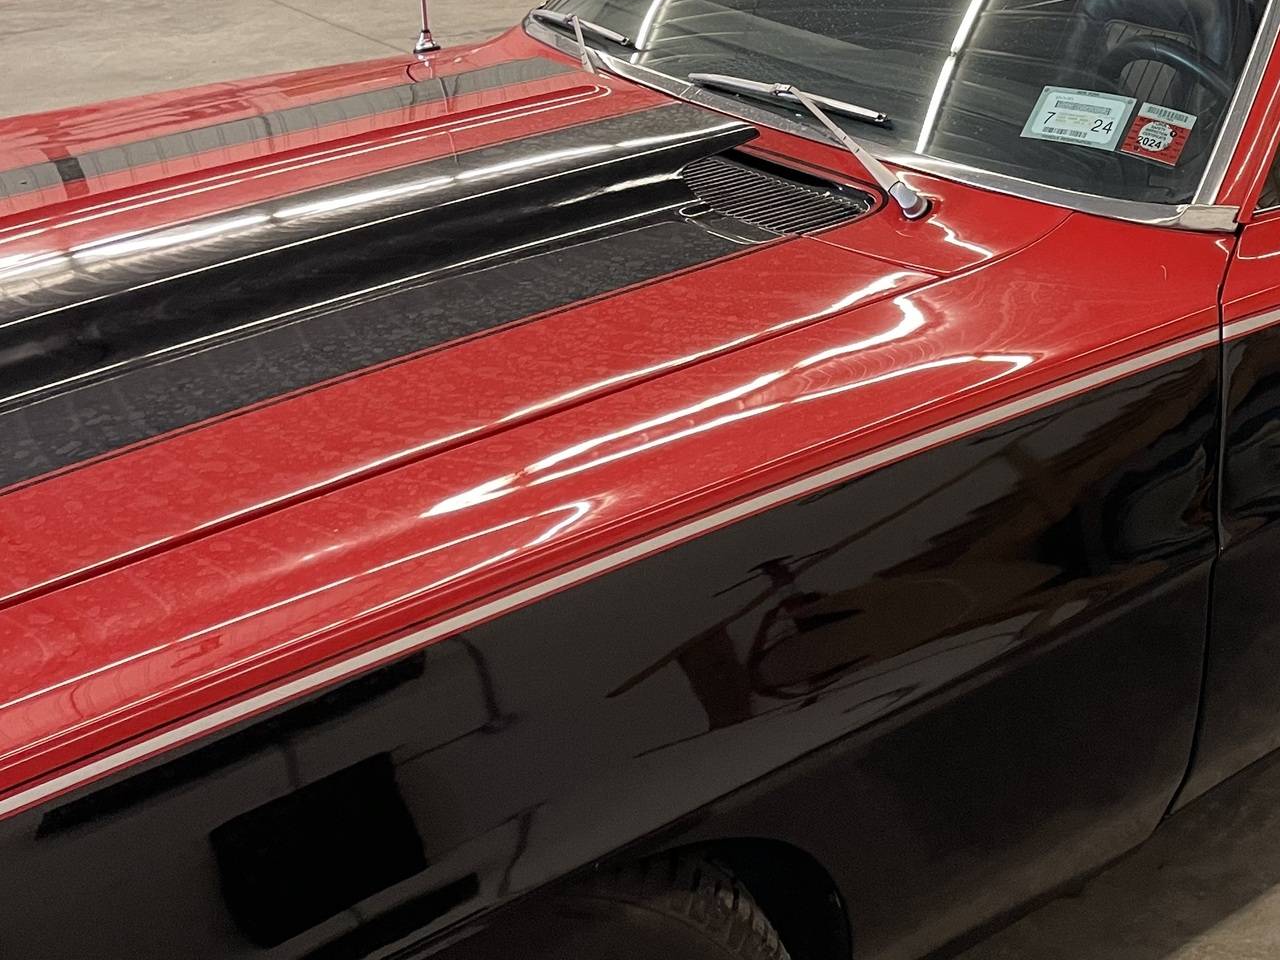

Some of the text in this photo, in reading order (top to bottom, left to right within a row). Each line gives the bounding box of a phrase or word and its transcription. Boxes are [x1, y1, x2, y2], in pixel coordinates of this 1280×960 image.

[1043, 111, 1056, 125] 7
[1090, 119, 1114, 134] 24
[1136, 136, 1162, 148] 2024
